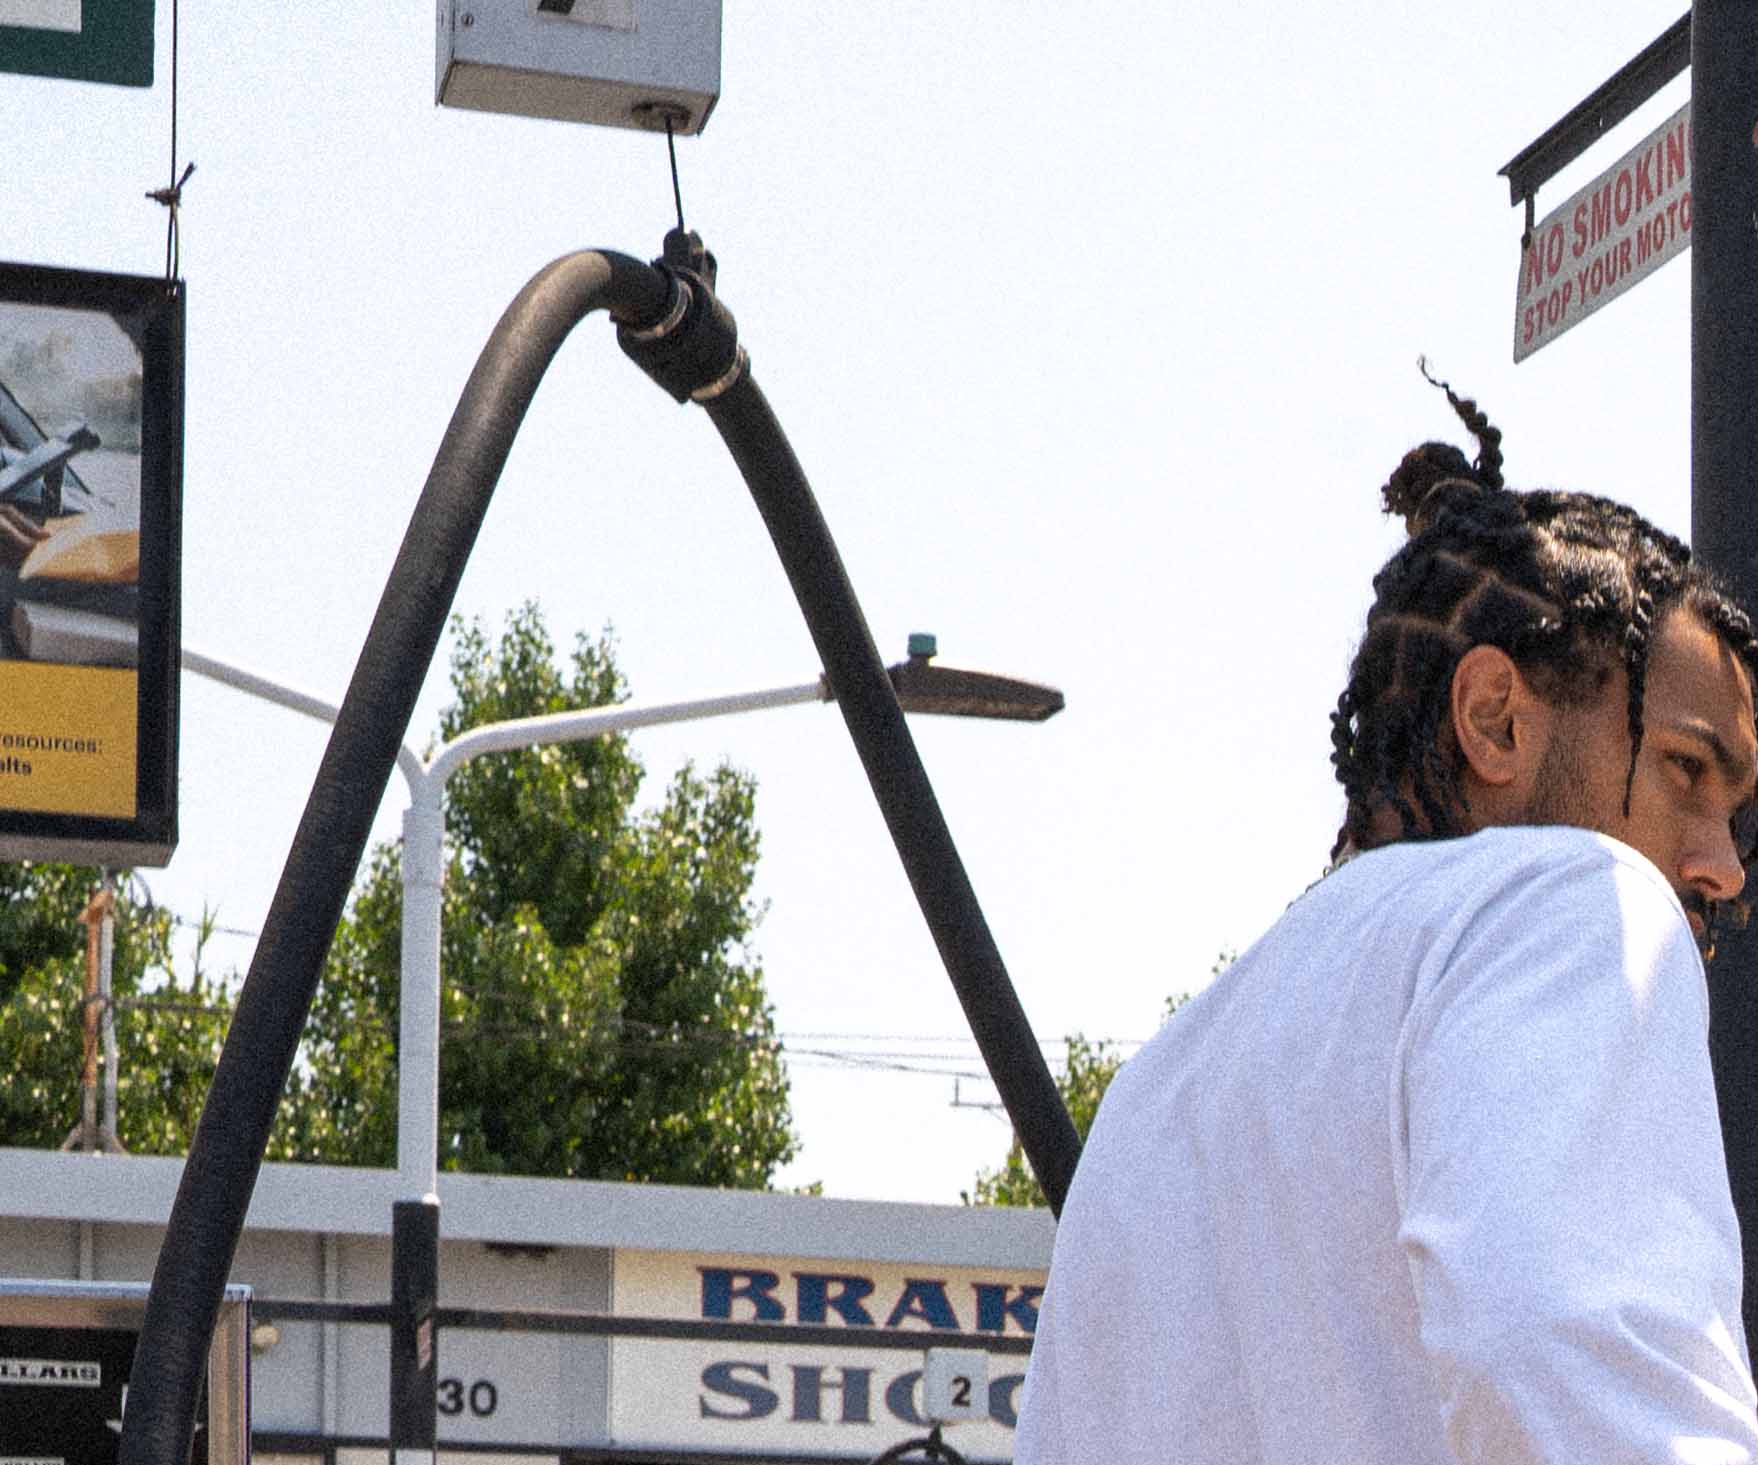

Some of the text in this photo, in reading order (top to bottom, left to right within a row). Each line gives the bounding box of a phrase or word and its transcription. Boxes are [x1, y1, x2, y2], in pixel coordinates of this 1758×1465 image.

[1525, 121, 1692, 295] NO SMOKIN
[1523, 280, 1573, 345] STOP
[1577, 237, 1632, 306] YOUR
[437, 1378, 498, 1418] 30
[951, 1376, 972, 1408] 2
